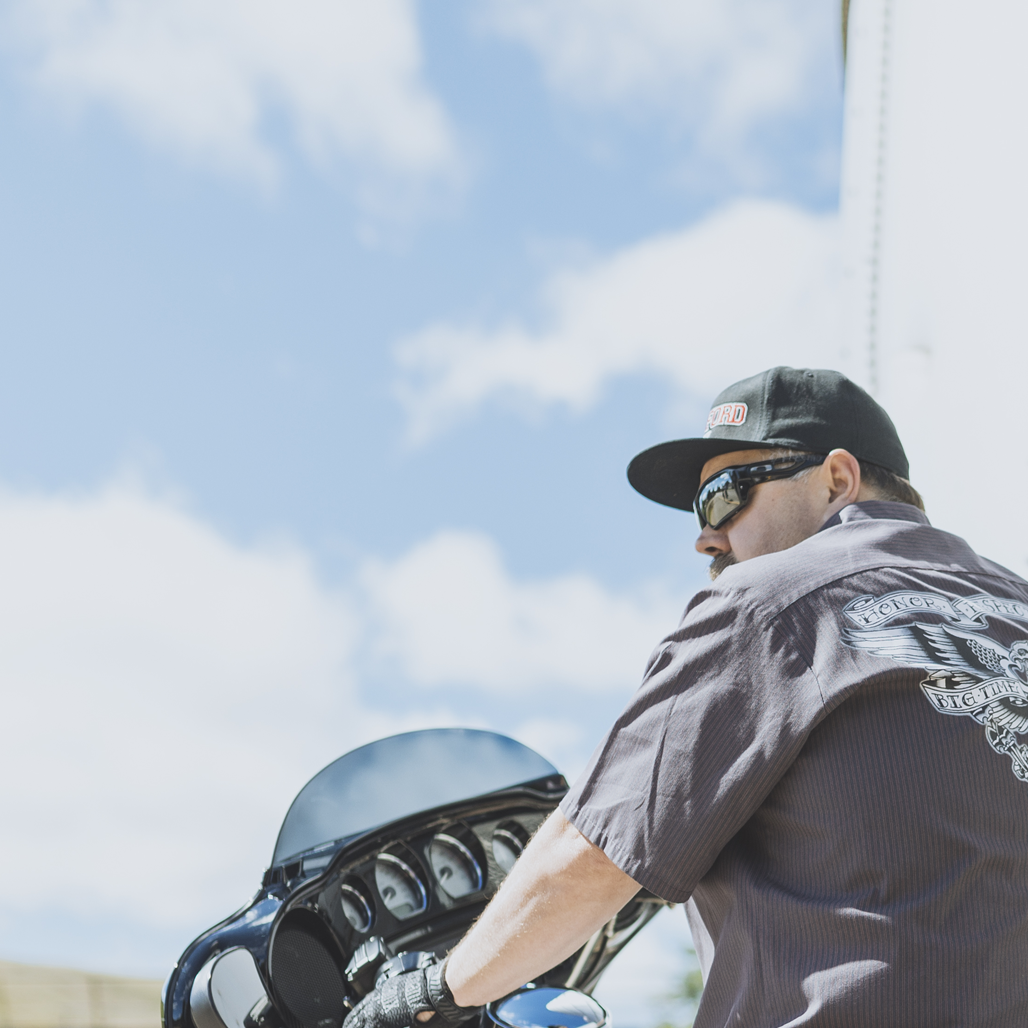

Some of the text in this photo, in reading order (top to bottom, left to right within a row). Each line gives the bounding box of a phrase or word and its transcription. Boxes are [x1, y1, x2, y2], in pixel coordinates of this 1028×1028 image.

[857, 596, 942, 624] HONOR
[930, 680, 1022, 709] BIG TIME
